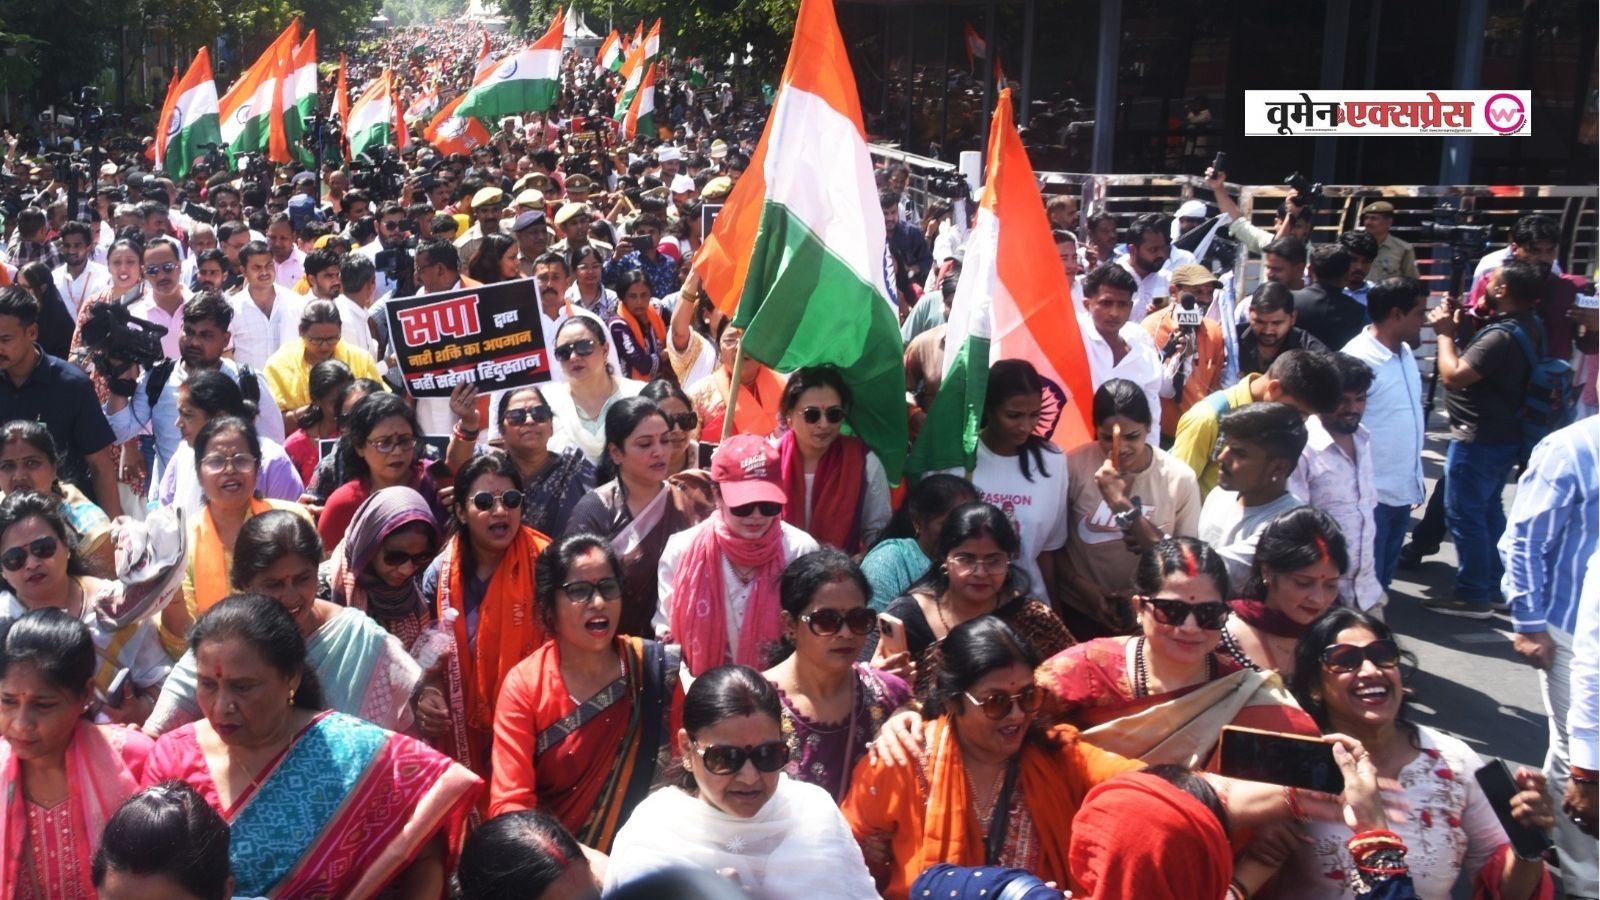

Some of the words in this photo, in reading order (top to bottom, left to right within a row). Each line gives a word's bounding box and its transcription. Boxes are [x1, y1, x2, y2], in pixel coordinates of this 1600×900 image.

[397, 294, 481, 347] सपा
[493, 310, 519, 328] द्वारा
[1178, 313, 1198, 323] ANI
[408, 349, 433, 367] नारी
[434, 344, 462, 362] शक्ति
[463, 342, 481, 356] का
[482, 330, 532, 351] अपमान
[410, 373, 435, 390] नहीं
[435, 367, 477, 389] सहेगा
[477, 353, 541, 381] हिंदुस्तान
[979, 492, 1032, 506] FASHION
